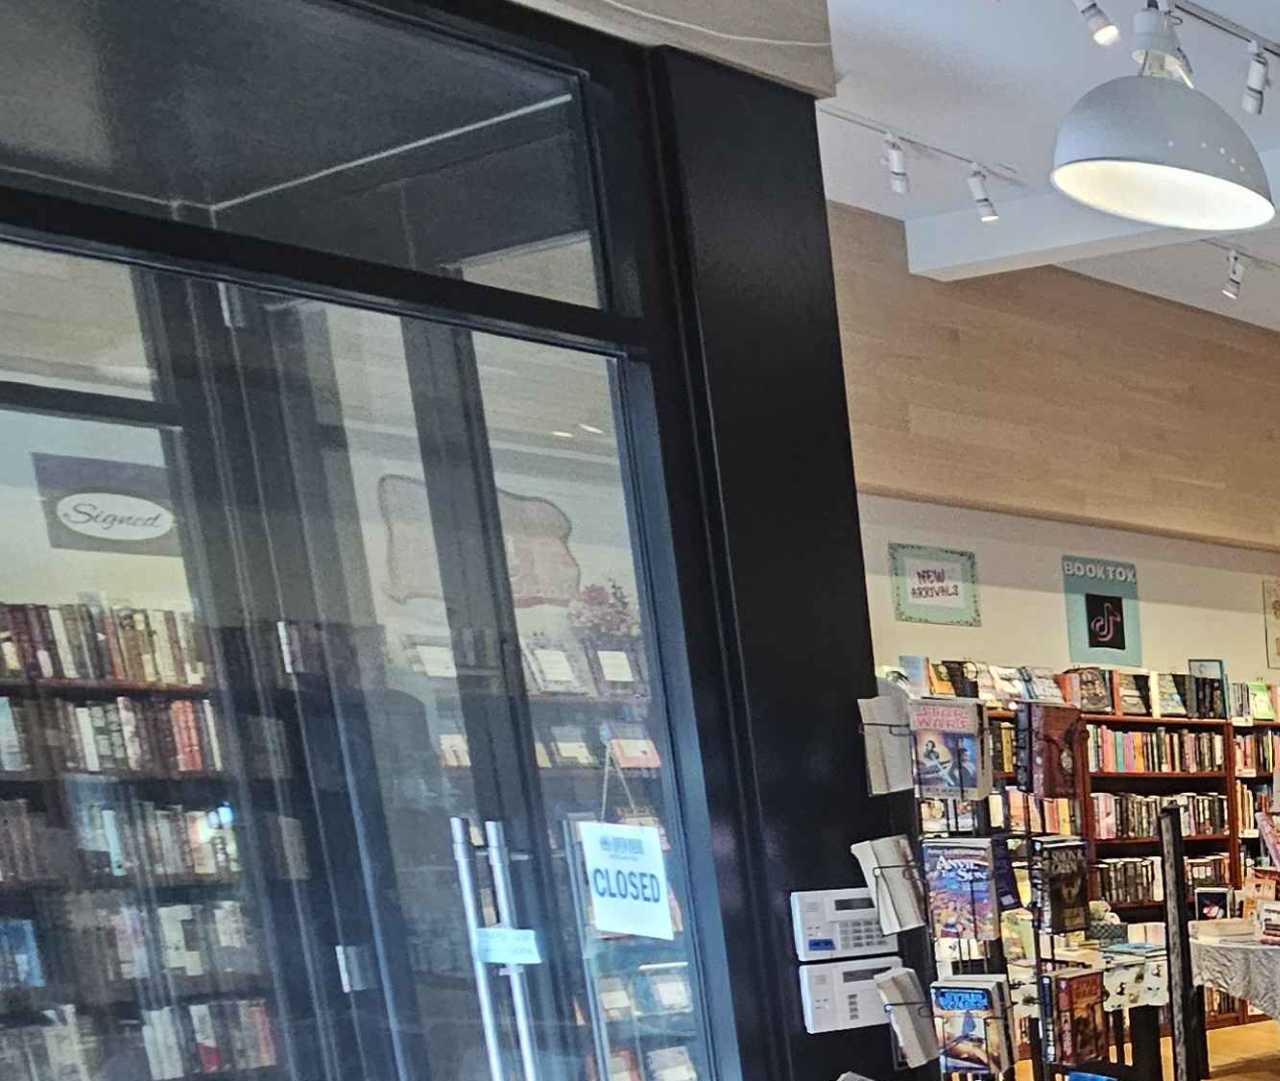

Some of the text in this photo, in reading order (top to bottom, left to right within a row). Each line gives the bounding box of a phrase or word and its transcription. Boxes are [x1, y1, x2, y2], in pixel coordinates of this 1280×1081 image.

[63, 503, 161, 530] Signed
[917, 570, 946, 583] NEW
[1063, 561, 1136, 582] BOOKTOK
[911, 584, 959, 598] ARRIVALS
[593, 868, 661, 903] CLOSED
